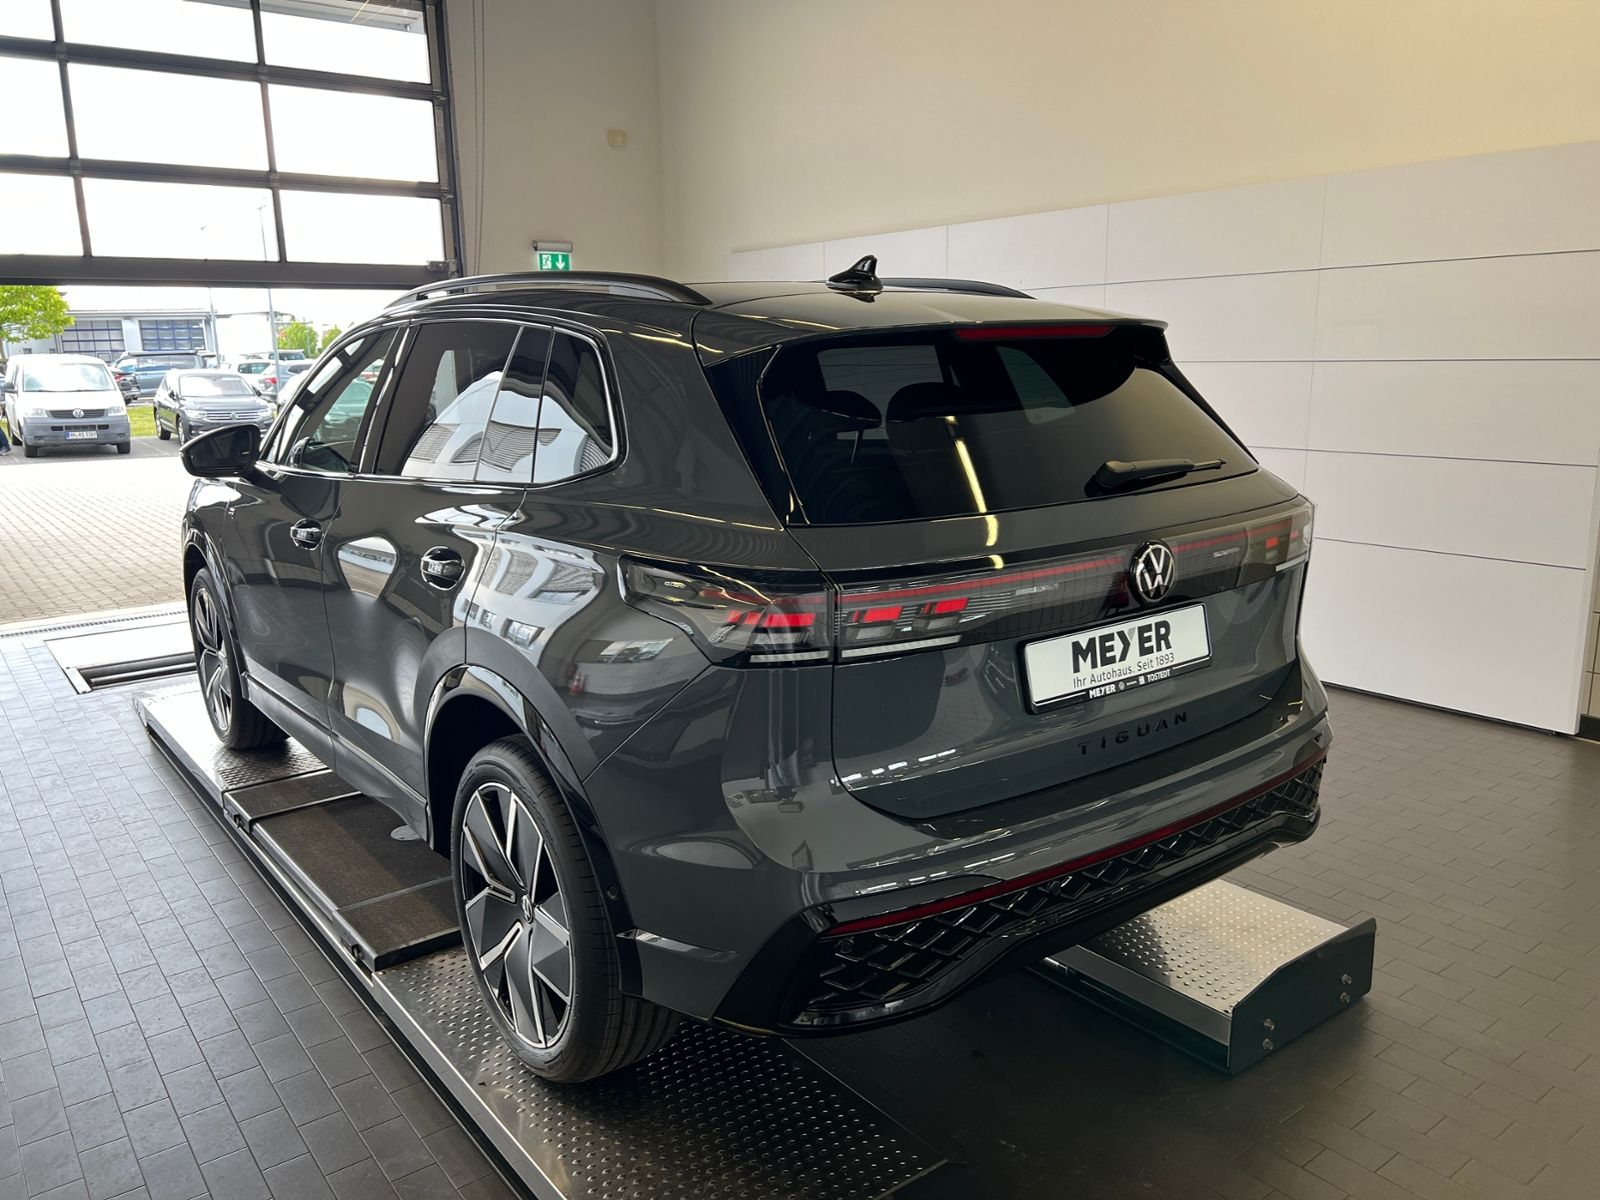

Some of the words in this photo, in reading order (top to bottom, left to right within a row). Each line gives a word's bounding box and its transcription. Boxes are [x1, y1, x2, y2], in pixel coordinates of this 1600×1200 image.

[1071, 620, 1172, 674] MEYER
[1073, 676, 1087, 689] Ihr
[1090, 665, 1135, 684] Autohaus.
[1137, 658, 1154, 672] Seit
[1155, 652, 1175, 667] 1893
[1089, 683, 1116, 699] MEYER
[1077, 711, 1187, 756] TIGUAN
